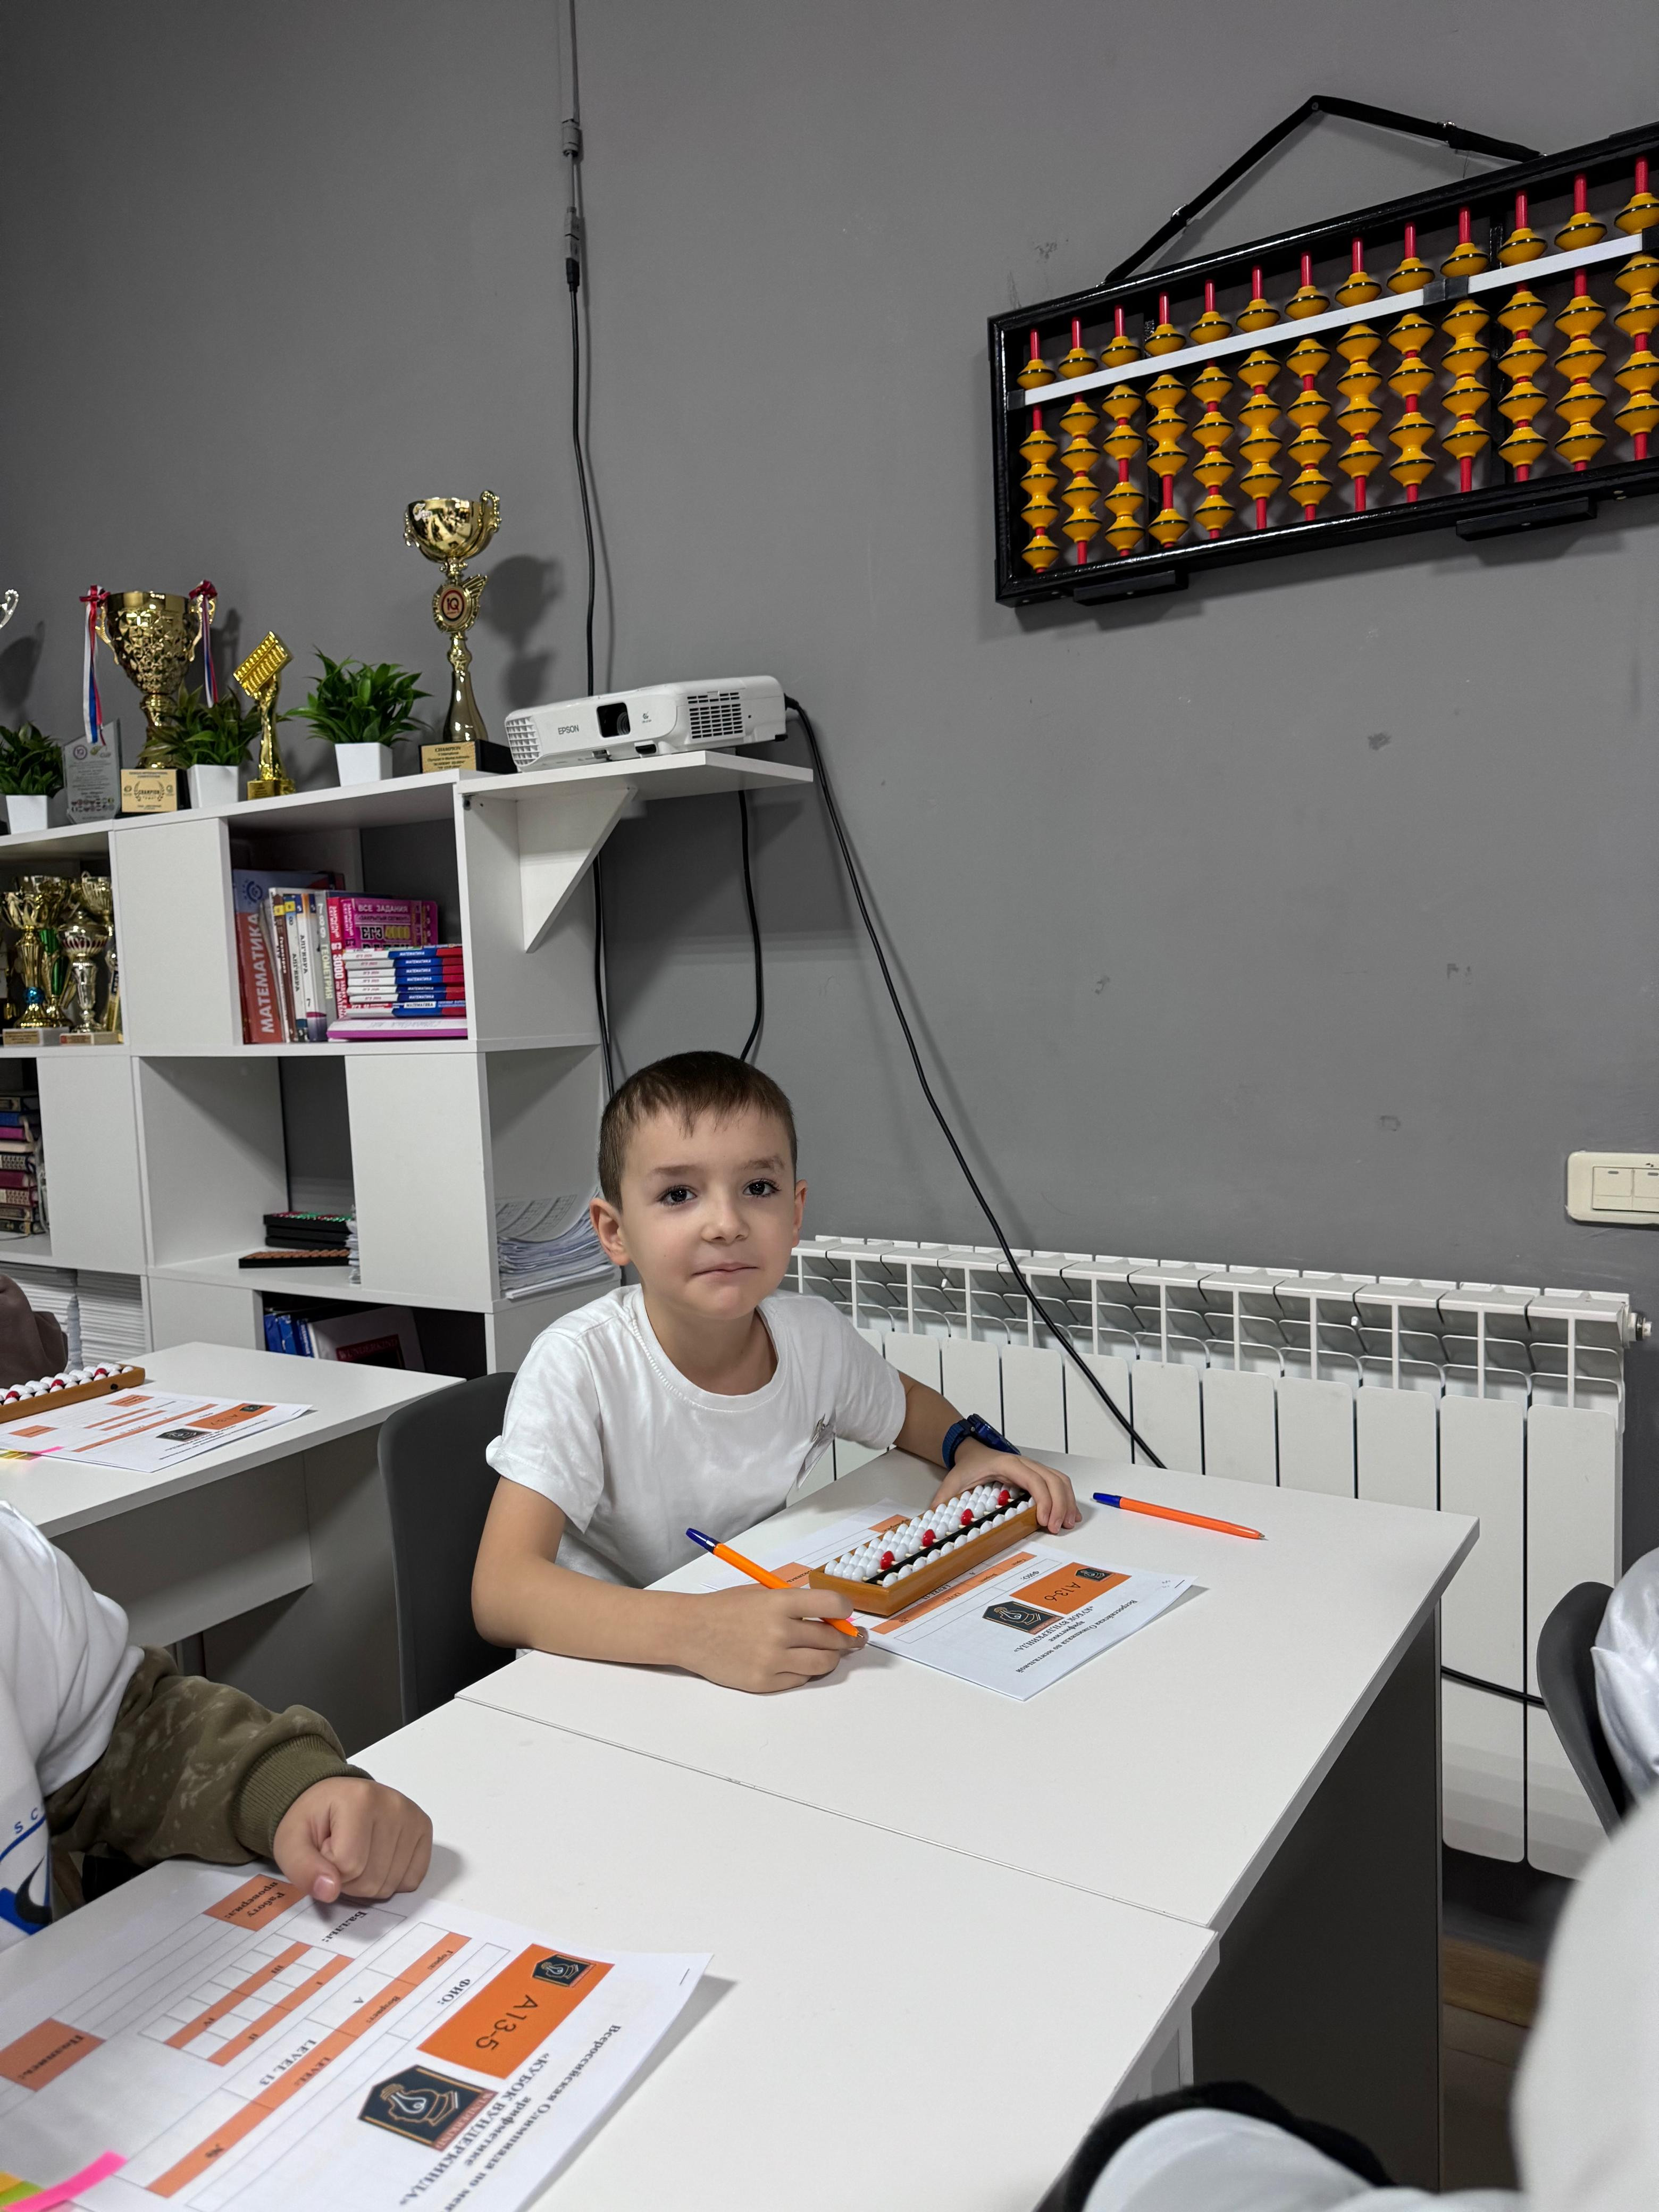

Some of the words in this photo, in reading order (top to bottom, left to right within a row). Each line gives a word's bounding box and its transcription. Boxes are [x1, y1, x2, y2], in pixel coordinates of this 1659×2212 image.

[447, 598, 459, 610] IQ
[558, 725, 579, 735] EPSON
[362, 927, 382, 939] ЕГЭ
[247, 913, 275, 1033] МАТЕМАТИКА
[321, 944, 333, 999] ГЕОМЕТРИЯ
[333, 954, 344, 979] 3000
[306, 998, 311, 1007] 7
[1071, 1606, 1094, 1619] «КУБОК
[1098, 1599, 1138, 1625] Всероссийская
[1014, 1620, 1070, 1652] ВУНДЕРКИНДА»
[1049, 1621, 1085, 1642] арифметике
[1061, 1625, 1097, 1645] Олимпиада
[1016, 1649, 1054, 1673] ментальной
[224, 1881, 279, 1918] проверил:
[247, 1892, 286, 1917] Работу
[321, 1911, 367, 1942] Баллы:
[437, 1979, 471, 2005] ФИО:
[18, 2035, 85, 2080] Подпись:
[273, 2039, 317, 2073] LEVEL
[549, 2024, 621, 2102] Всероссийская
[259, 2074, 275, 2086] 13
[294, 2057, 332, 2086] LEVEL:
[501, 2052, 549, 2101] «КУБОК
[465, 2096, 532, 2167] арифметике
[484, 2103, 551, 2171] Олимпиада
[399, 2101, 505, 2206] ВУНДЕРКИНДА»
[468, 2171, 488, 2188] по
